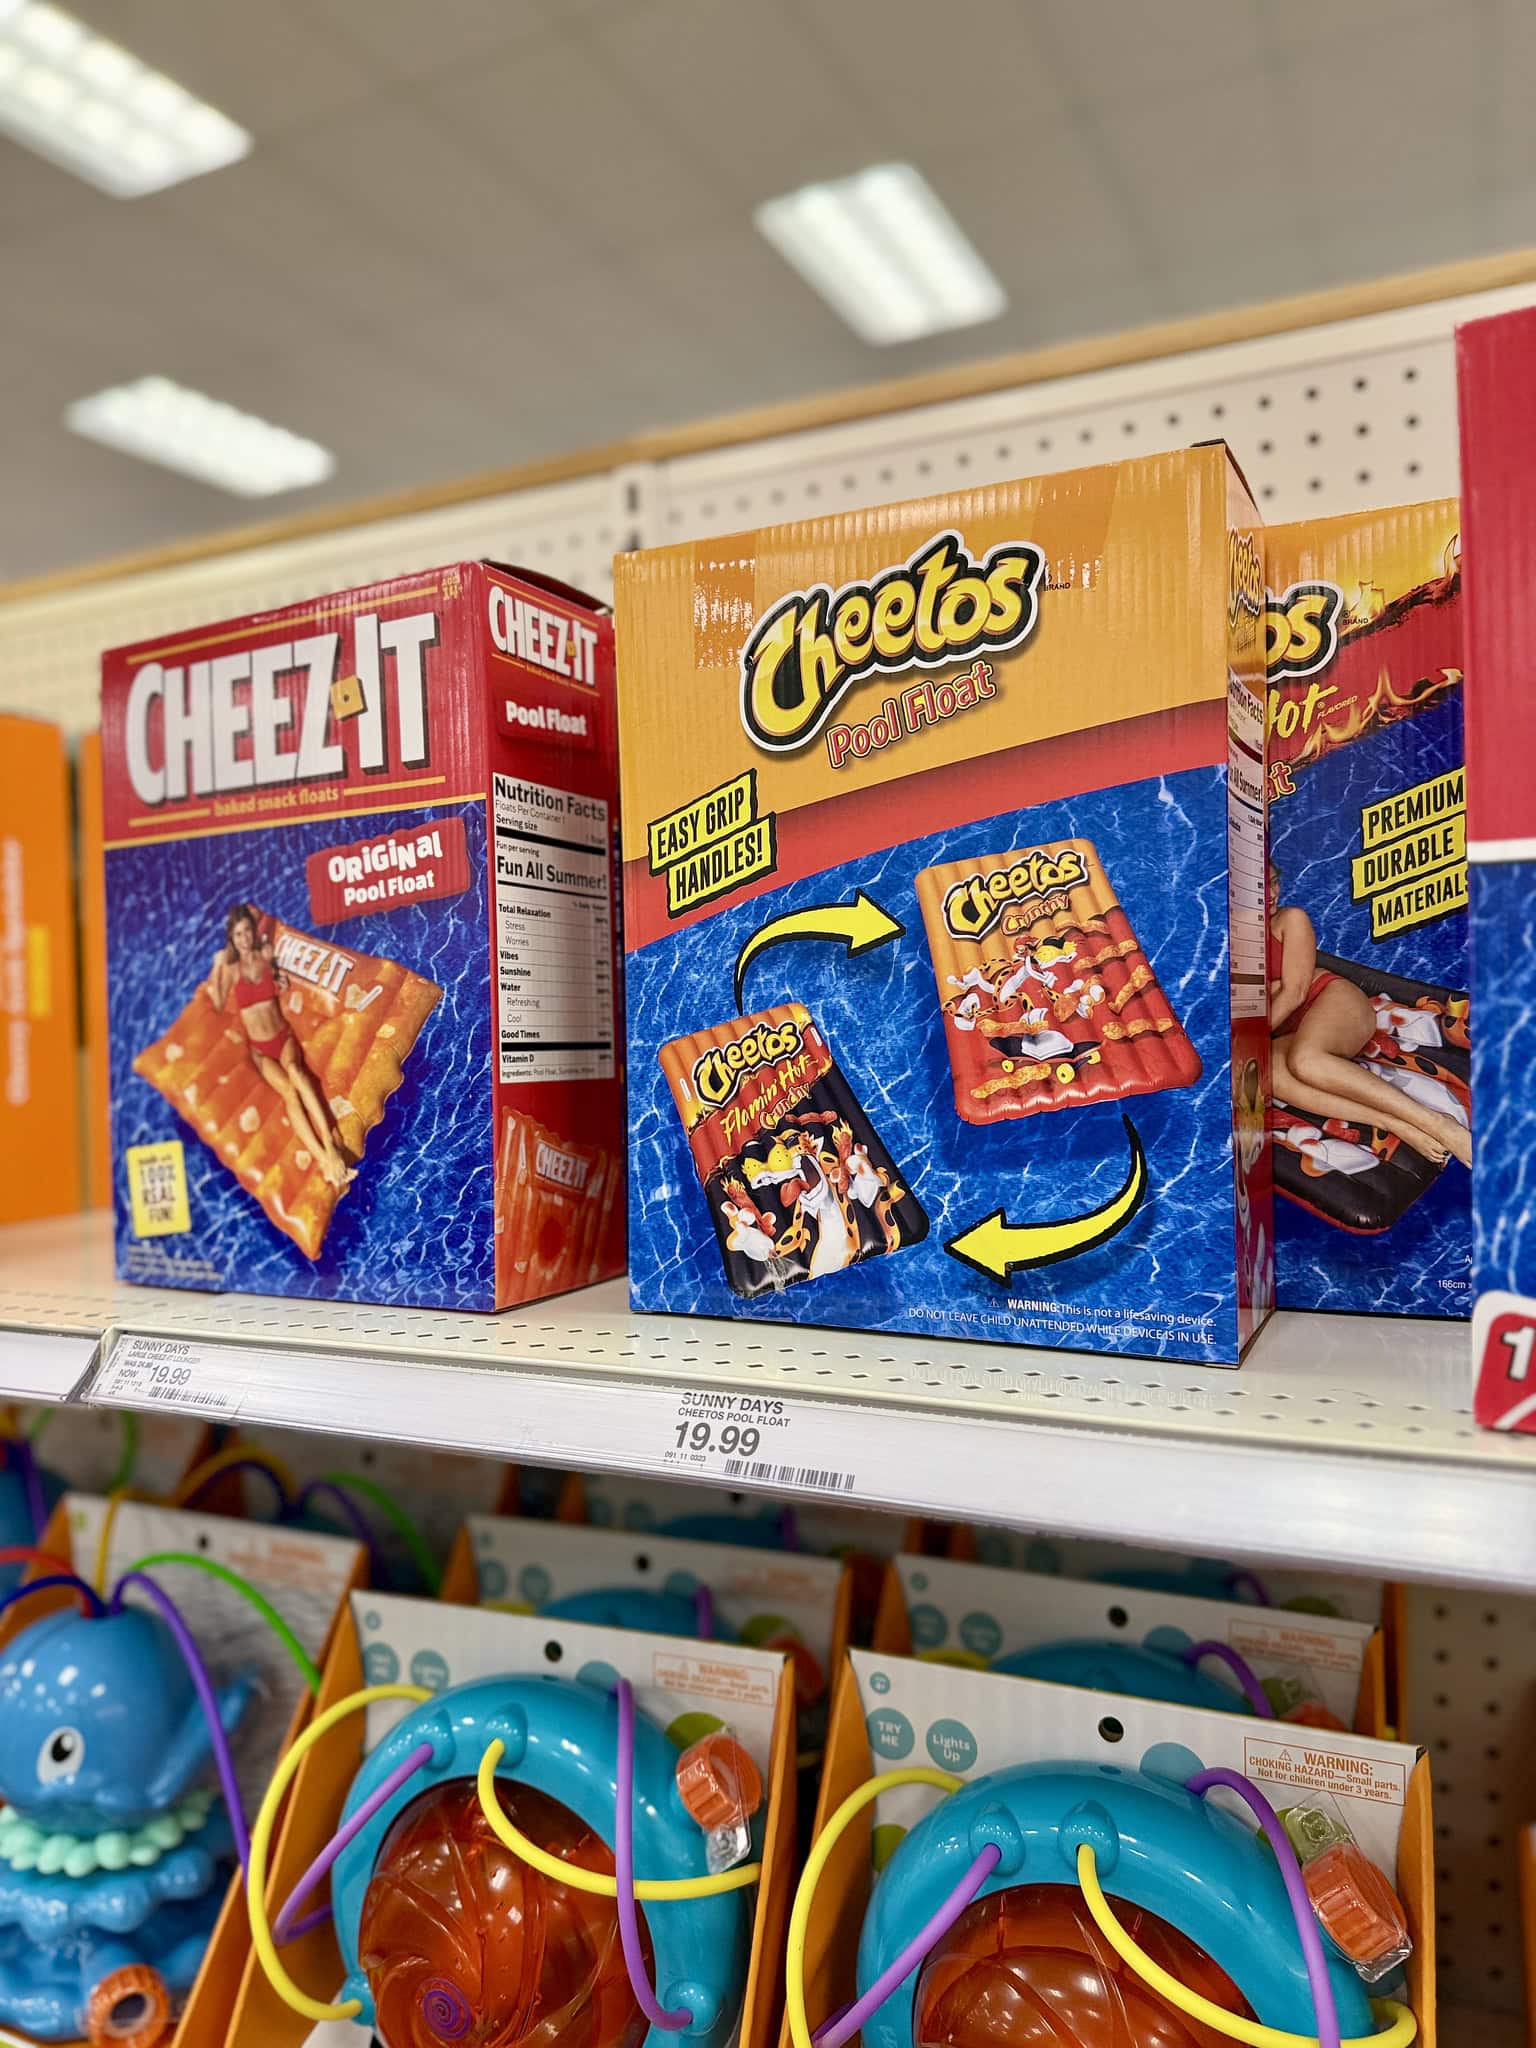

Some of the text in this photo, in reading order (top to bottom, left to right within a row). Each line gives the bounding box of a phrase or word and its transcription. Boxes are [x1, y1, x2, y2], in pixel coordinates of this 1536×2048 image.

[744, 535, 1040, 746] Cheetos
[505, 700, 587, 737] Pool Float
[827, 662, 995, 768] Pool Float
[214, 787, 339, 817] baked snack floats
[495, 776, 606, 822] Nutrition Facts
[1368, 774, 1464, 840] PREMIUM
[496, 813, 538, 831] Serving size
[657, 787, 744, 860] EASY GRIP
[496, 840, 507, 850] Fun
[519, 846, 540, 857] serving
[1364, 827, 1453, 888] DURABLE
[497, 856, 607, 890] Fun All Summer!
[676, 827, 763, 902] HANDLES!
[388, 870, 435, 897] Float
[944, 852, 1086, 938] Cheetos
[498, 903, 551, 918] Total Relaxation
[500, 951, 519, 960] Vibes
[500, 967, 531, 977] Sunshine
[500, 983, 521, 992] Water
[501, 1030, 540, 1039] Good Times
[502, 1054, 528, 1063] Vitamin
[692, 1021, 802, 1108] Cheetos
[1437, 1279, 1466, 1289] 166cm
[1007, 1298, 1060, 1313] WARNING:
[1060, 1303, 1081, 1315] This
[1084, 1306, 1091, 1316] is
[1094, 1308, 1112, 1318] not
[1123, 1309, 1174, 1325] lifesaving
[1177, 1314, 1217, 1327] device.
[908, 1308, 924, 1318] DO
[926, 1309, 947, 1320] NOT
[950, 1311, 978, 1322] LEAVE
[981, 1314, 1011, 1326] CHILD
[1013, 1317, 1085, 1333] UNATTENDED
[1086, 1324, 1121, 1336] WHILE
[1177, 1332, 1189, 1342] IN
[1192, 1333, 1217, 1345] USE.
[133, 1340, 165, 1352] SUNNY
[165, 1343, 190, 1355] DAYS
[119, 1369, 139, 1378] NOW
[150, 1365, 191, 1385] 19.99
[681, 1392, 784, 1415] SUNNY DAYS
[678, 1407, 791, 1428] CHEETOS POOL FLOAT
[675, 1421, 760, 1457] 19.99
[878, 1720, 901, 1734] TRY
[880, 1734, 899, 1746] ME
[932, 1733, 970, 1751] Lights
[943, 1749, 960, 1762] Up
[1303, 1752, 1373, 1776] WARNING:
[1249, 1756, 1292, 1772] CHOKING
[1374, 1780, 1401, 1793] parts.
[1257, 1768, 1392, 1800] Not for children under 3 years.
